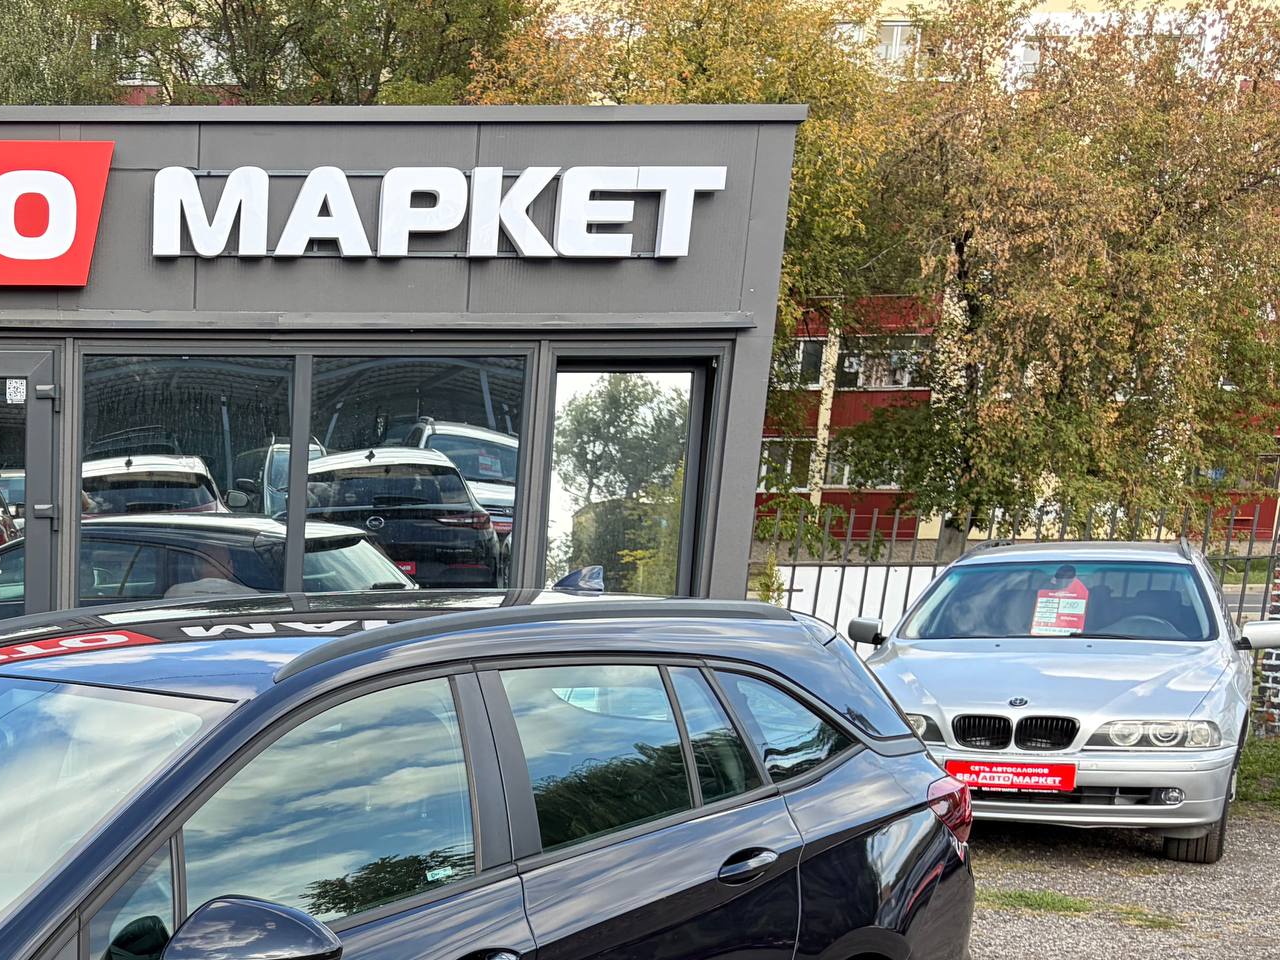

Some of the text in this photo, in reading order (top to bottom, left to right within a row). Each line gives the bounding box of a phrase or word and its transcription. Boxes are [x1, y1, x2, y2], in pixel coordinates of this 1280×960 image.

[152, 165, 728, 259] МАРКЕТ
[979, 774, 1011, 783] АВТО
[1013, 776, 1062, 785] МАРКЕТ
